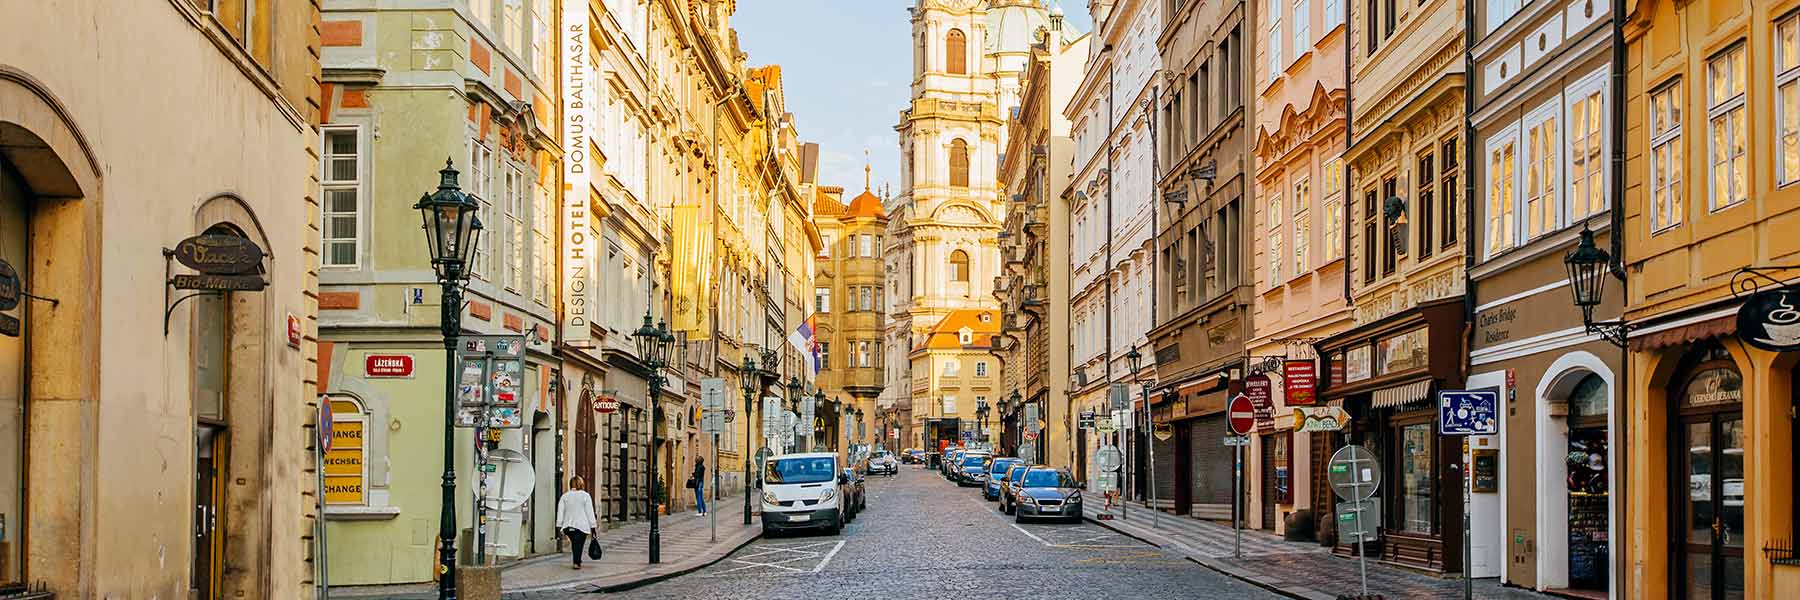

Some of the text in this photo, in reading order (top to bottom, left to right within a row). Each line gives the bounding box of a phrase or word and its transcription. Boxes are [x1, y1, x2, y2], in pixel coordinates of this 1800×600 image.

[570, 24, 585, 327] DESIGN HOTEL DOMUS BALTHASAR
